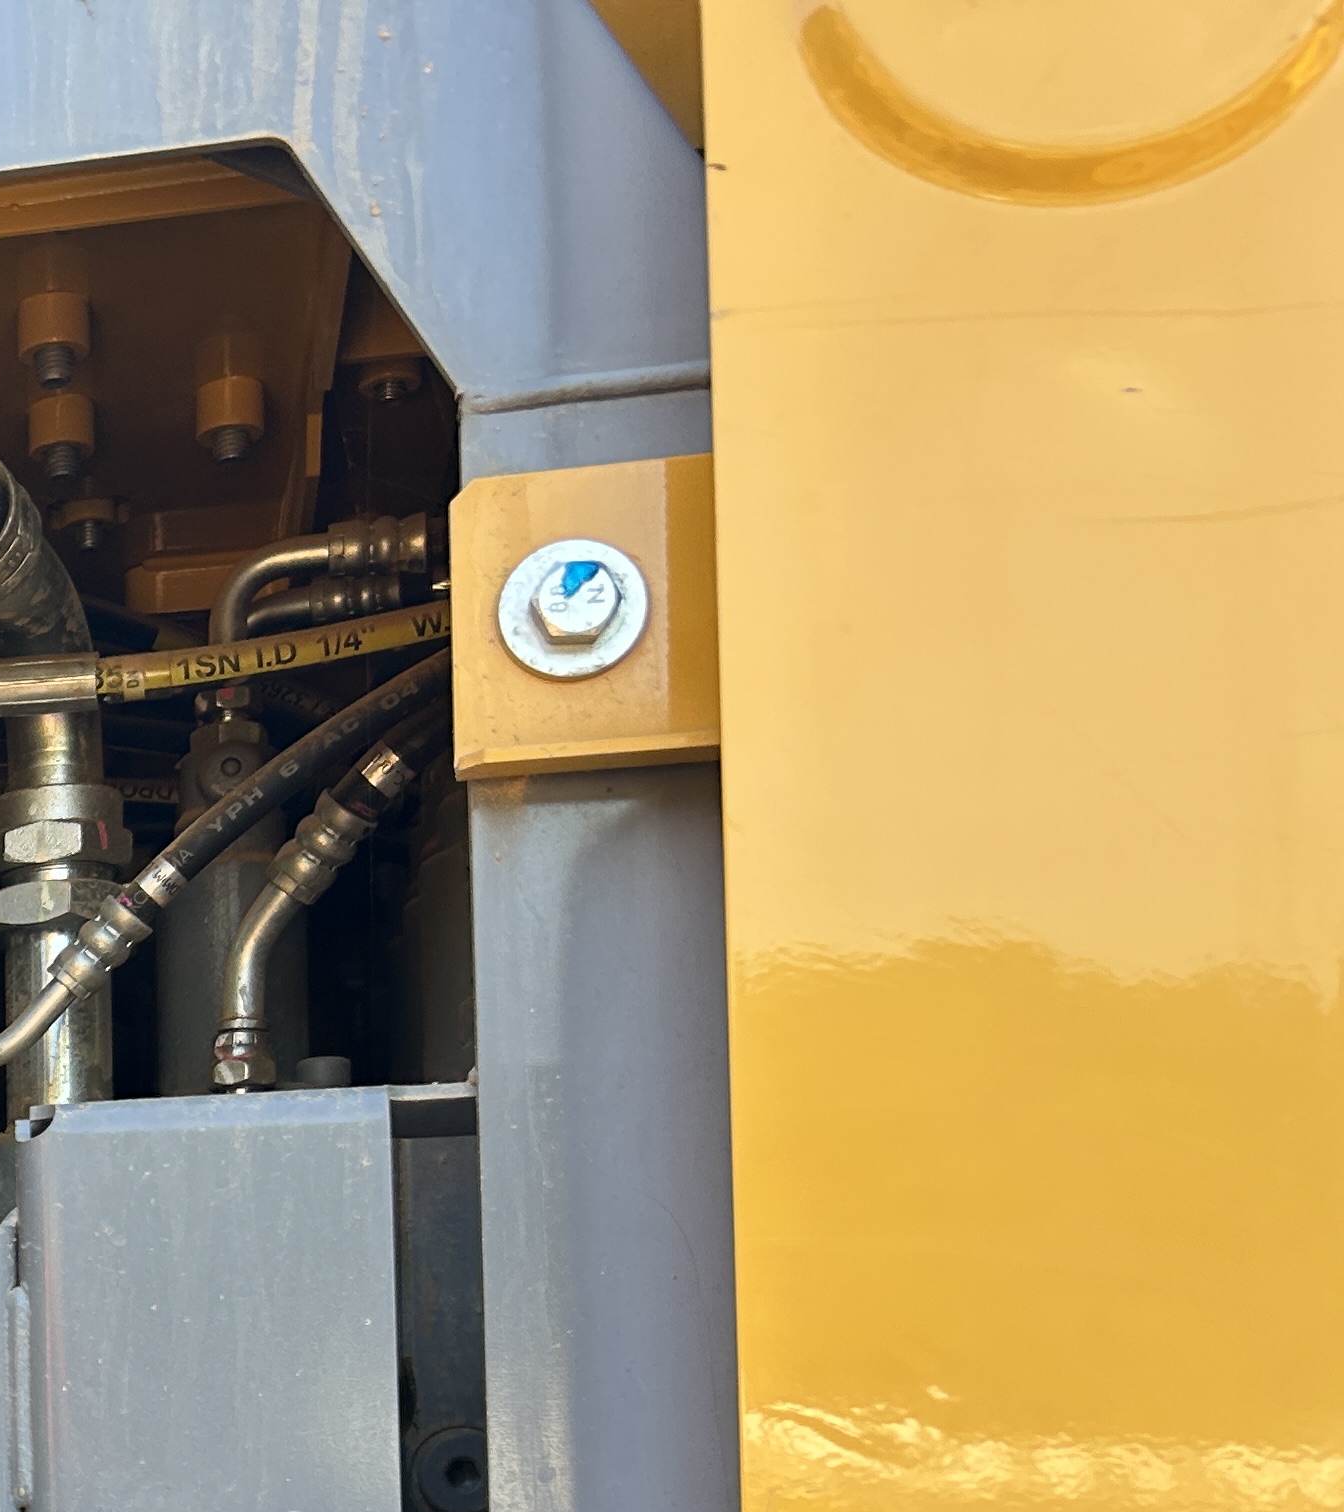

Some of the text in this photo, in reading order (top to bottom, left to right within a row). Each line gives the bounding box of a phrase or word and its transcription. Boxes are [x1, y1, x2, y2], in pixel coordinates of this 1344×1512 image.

[175, 651, 241, 681] 1SN
[255, 642, 297, 669] I.D
[206, 786, 264, 834] YPH
[279, 759, 300, 778] 6
